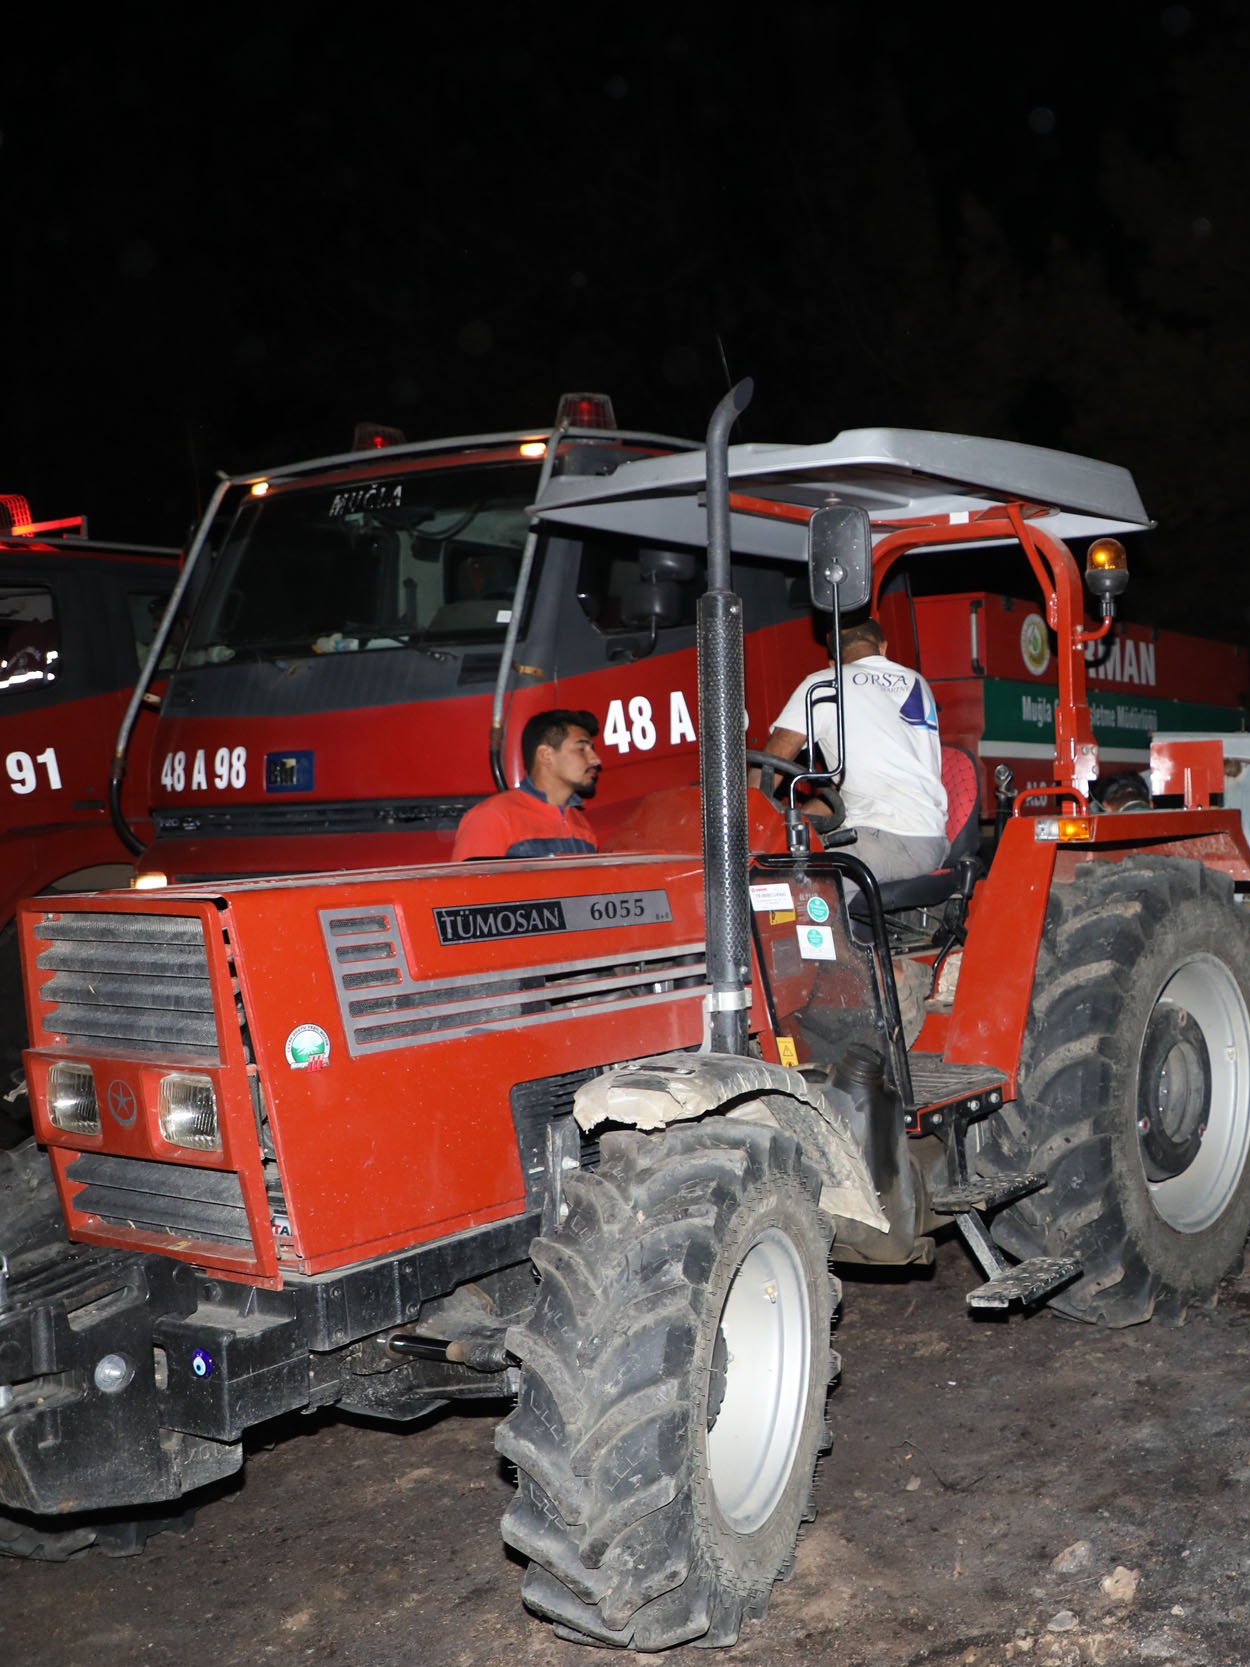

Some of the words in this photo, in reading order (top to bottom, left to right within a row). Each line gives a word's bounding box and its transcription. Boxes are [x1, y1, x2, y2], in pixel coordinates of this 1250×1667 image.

[852, 671, 908, 687] ORSA
[1085, 636, 1157, 687] RMAN
[603, 695, 657, 754] 48
[669, 690, 697, 745] A
[1022, 695, 1053, 728] Muğla
[5, 747, 63, 794] 91
[160, 750, 186, 792] 48
[191, 749, 208, 791] A
[214, 746, 247, 790] 98
[440, 907, 561, 939] TÜMOSAN
[590, 898, 645, 921] 6055
[272, 1223, 292, 1236] TA
